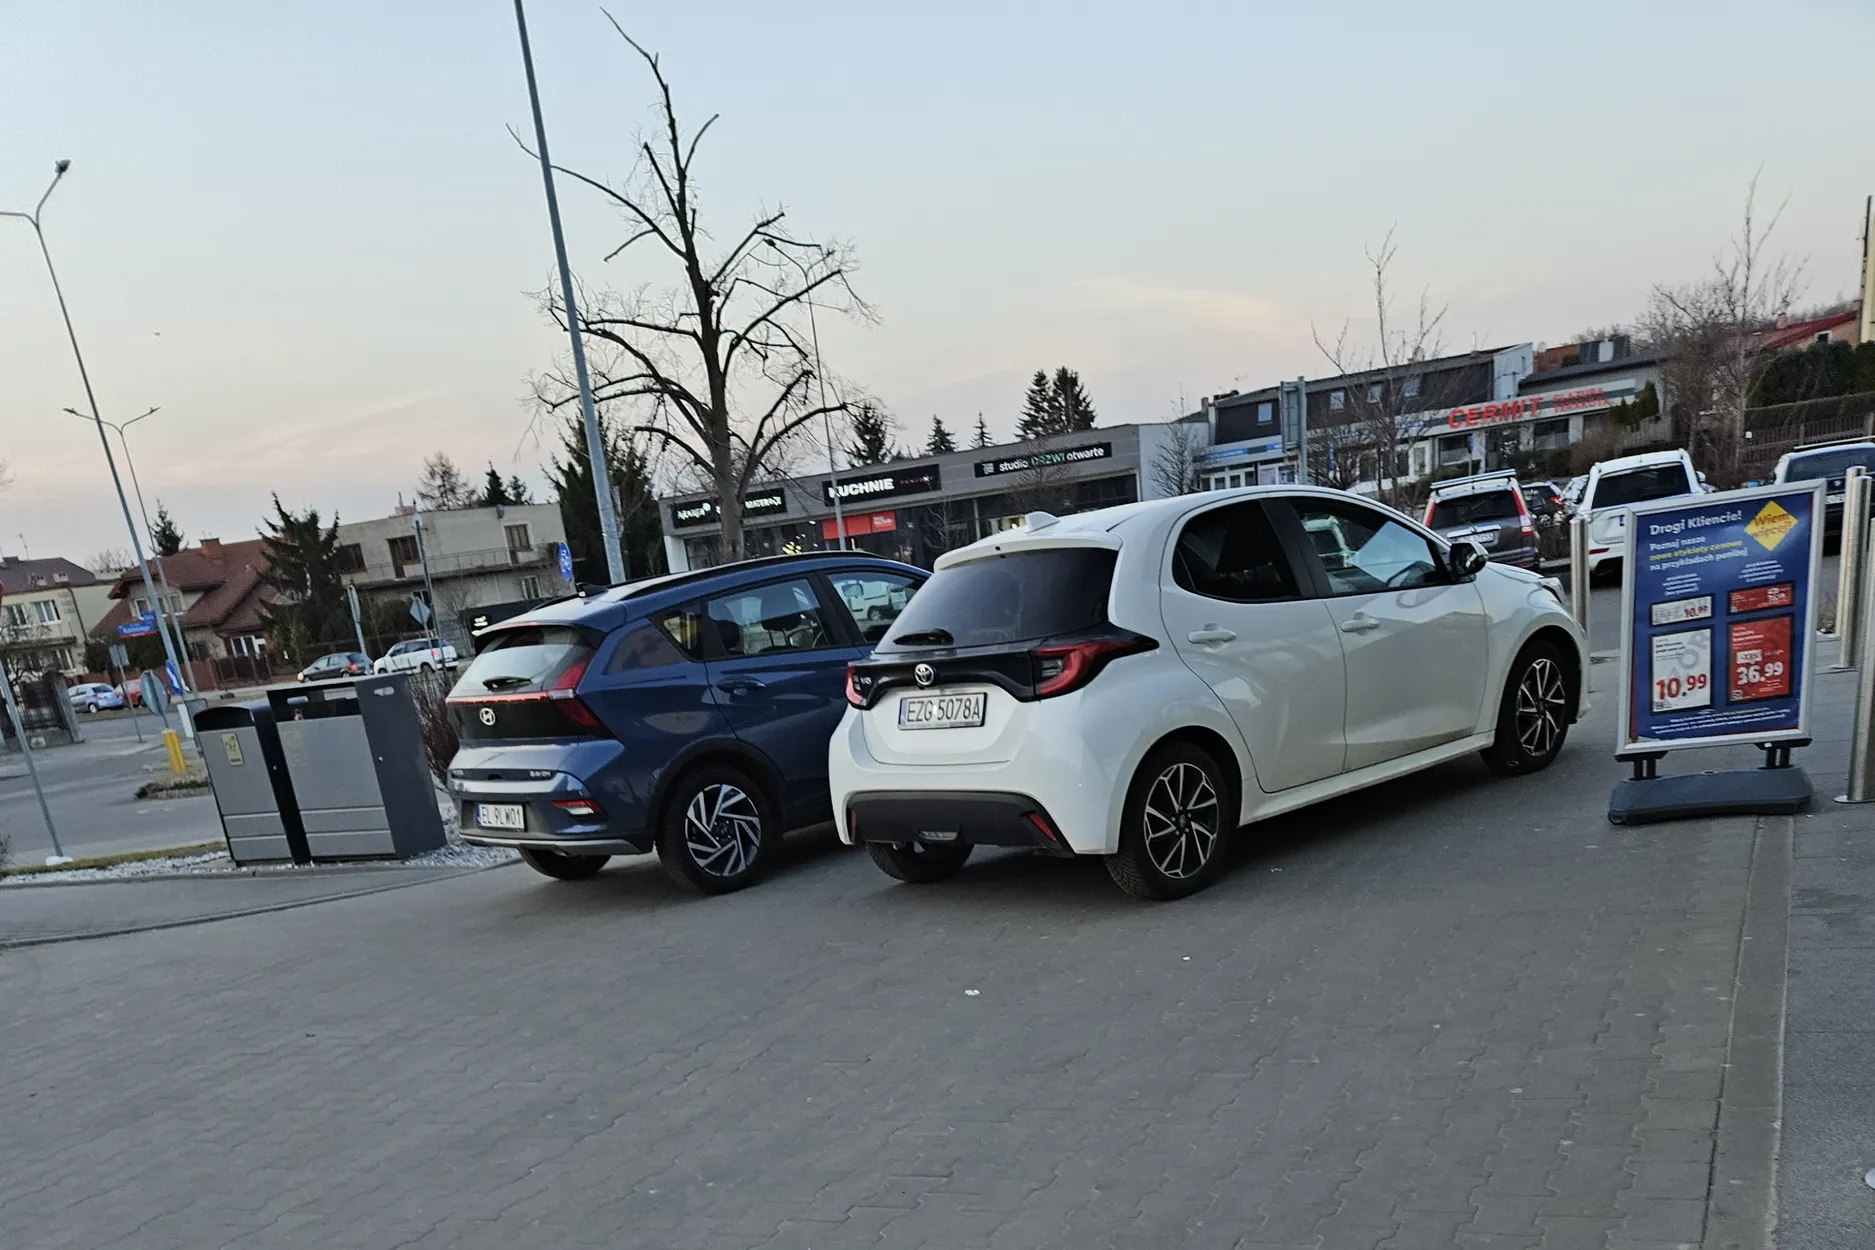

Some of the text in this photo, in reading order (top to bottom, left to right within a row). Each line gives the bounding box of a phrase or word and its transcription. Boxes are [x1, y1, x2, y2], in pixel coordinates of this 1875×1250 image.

[1448, 397, 1544, 429] CERMIT
[999, 447, 1105, 472] studio DRZWI otwarte
[828, 478, 895, 499] KUCHNIE
[1649, 510, 1742, 536] Drogi Kliencie!
[1754, 512, 1790, 527] Wiem
[1649, 536, 1706, 552] Poznaj nasze
[1650, 552, 1673, 561] nowe
[1710, 540, 1744, 551] cenowe
[1649, 563, 1661, 571] na
[1736, 661, 1784, 685] 36.99
[1655, 673, 1708, 700] 10.99
[907, 697, 980, 723] EZG 5078A
